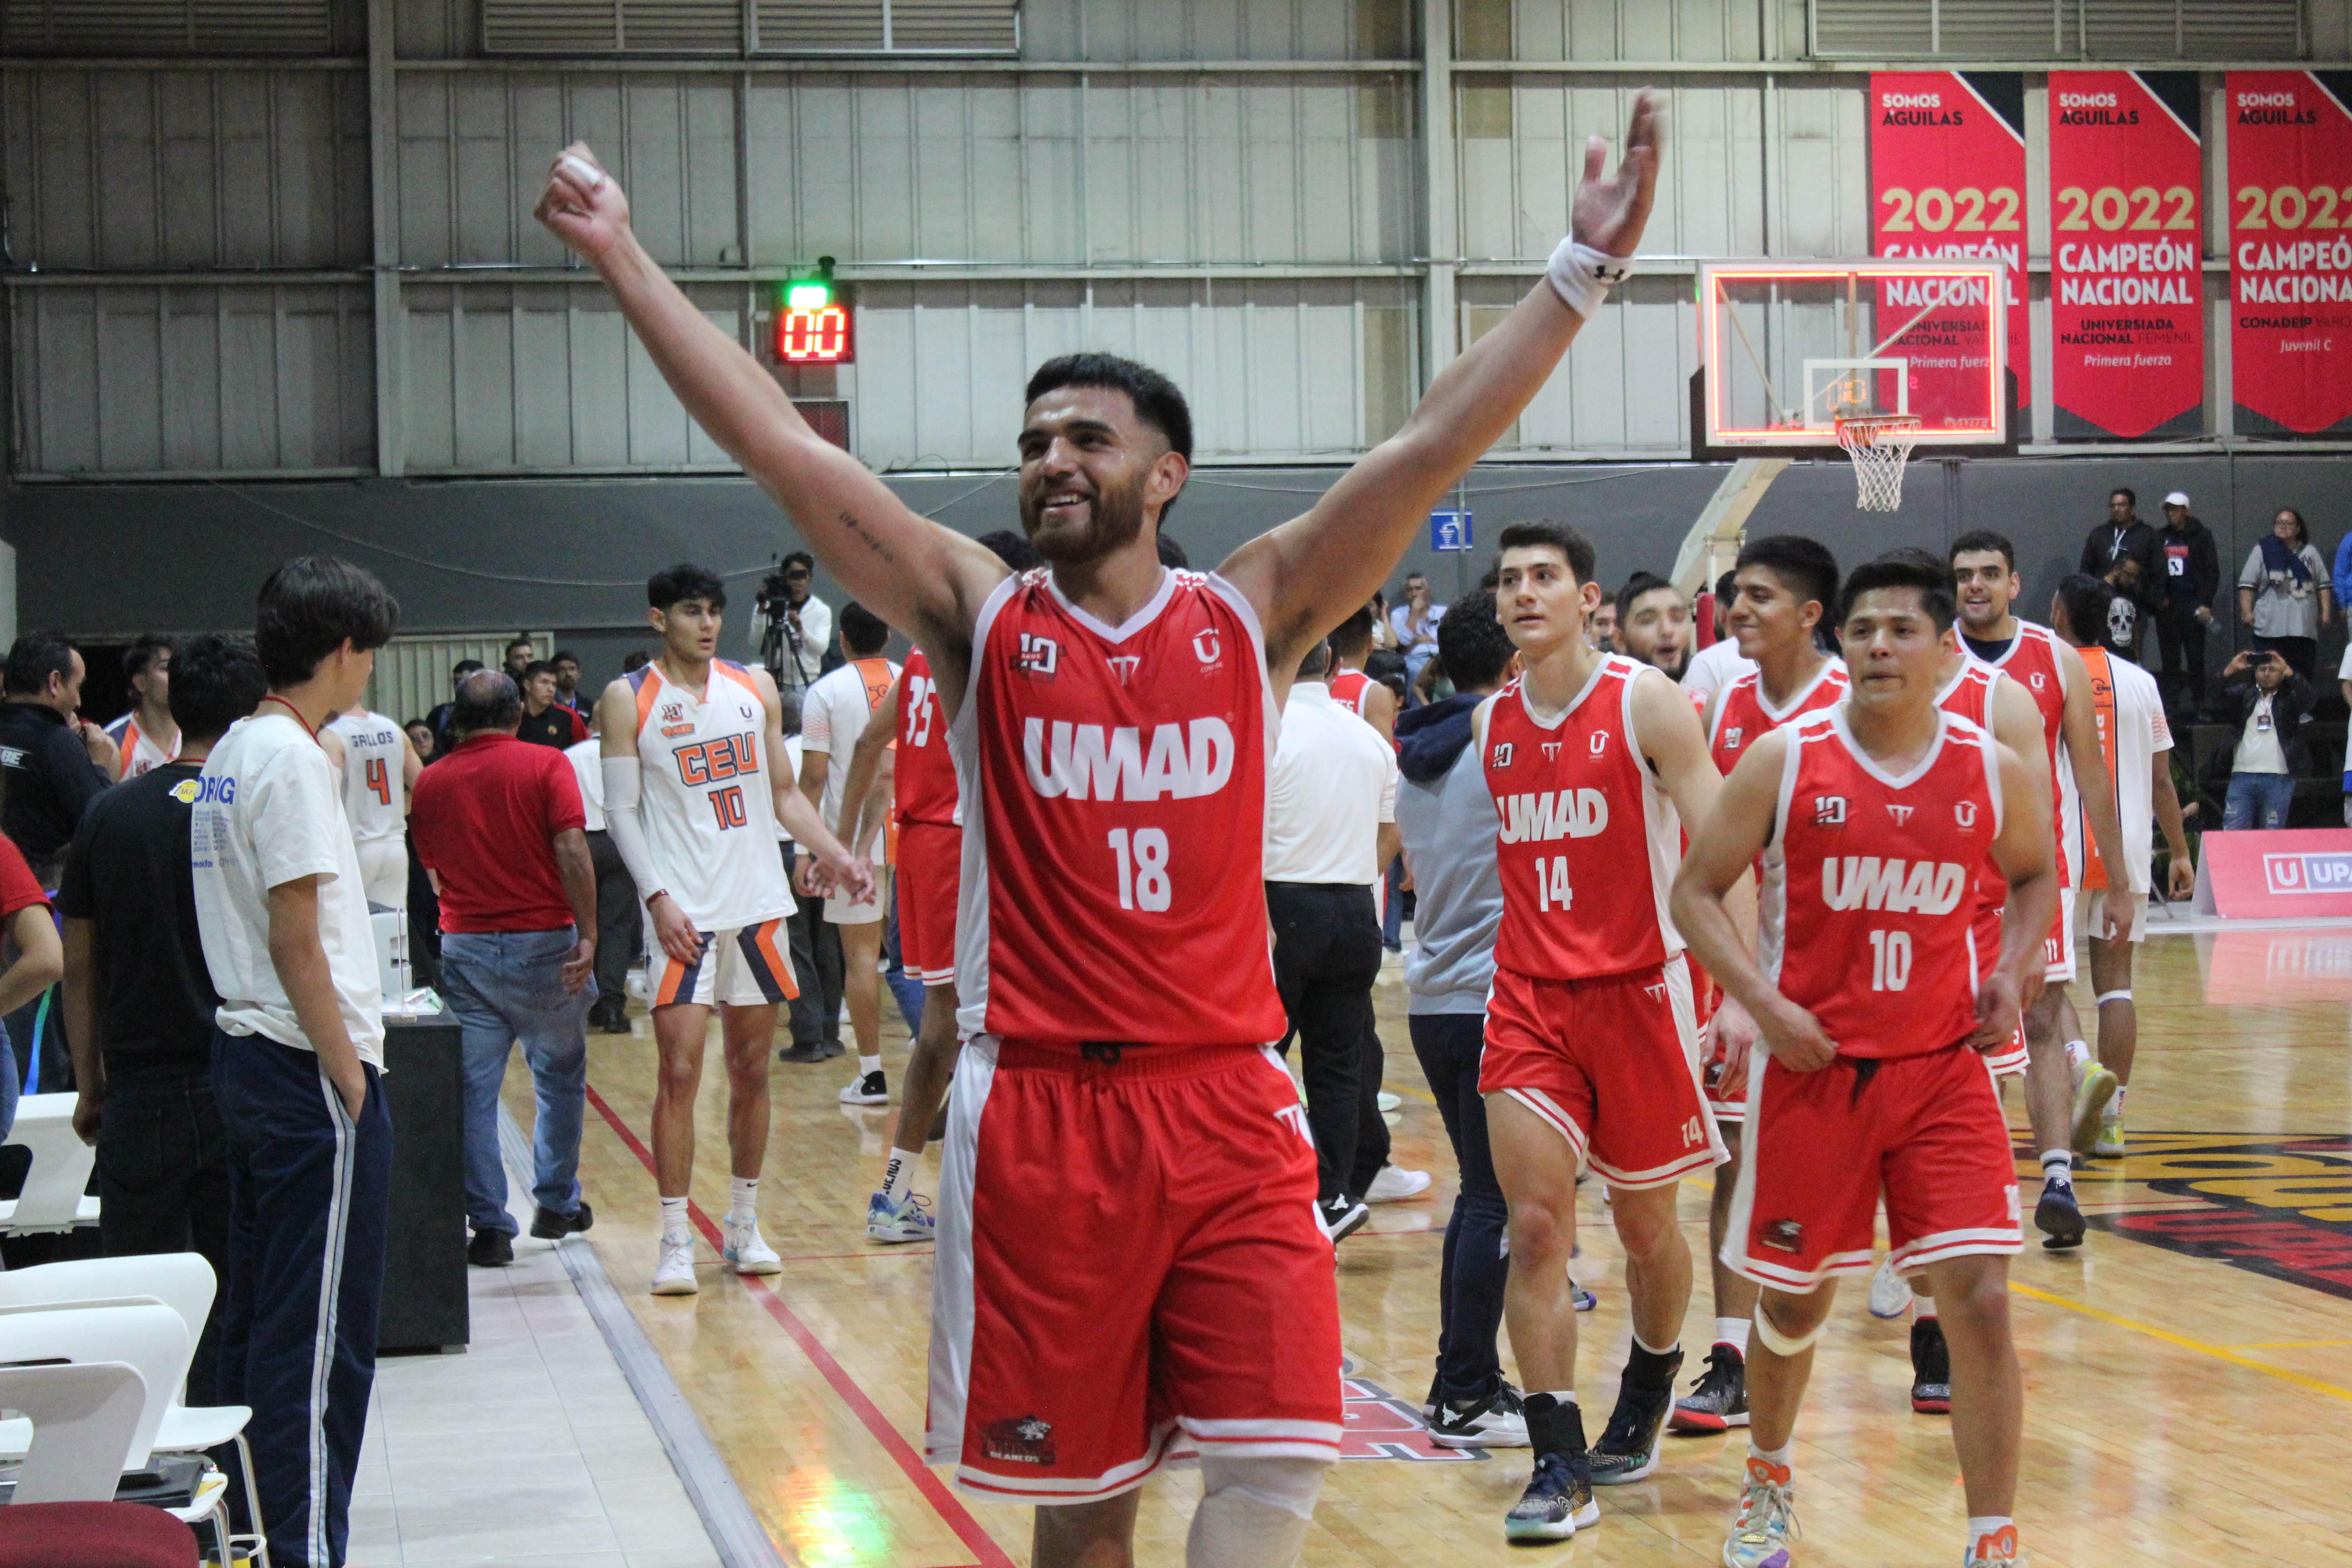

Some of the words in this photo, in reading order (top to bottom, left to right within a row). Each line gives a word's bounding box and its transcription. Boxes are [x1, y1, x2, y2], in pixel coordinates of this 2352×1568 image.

[1882, 93, 1940, 108] SOMOS
[2059, 93, 2117, 107] SOMOS
[2237, 93, 2294, 107] SOMOS
[1882, 187, 2020, 232] 2022
[2057, 186, 2195, 231] 2022
[2059, 236, 2193, 273] CAMPEÓN
[1886, 279, 2019, 307] NACIONL
[2061, 278, 2194, 305] NACIONAL
[784, 308, 845, 358] 00
[2081, 319, 2174, 331] UNIVERSIADA
[2240, 318, 2313, 328] CONADEIP
[1886, 334, 1960, 346] ACIONAL
[2061, 333, 2134, 344] NACIONAL
[2280, 340, 2320, 353] Juvenil
[2324, 340, 2332, 351] C
[1909, 356, 1957, 369] Primera
[2084, 354, 2131, 367] Primera
[2133, 353, 2172, 368] fuerza
[351, 732, 394, 747] GALLOS
[672, 731, 759, 787] CEU
[1023, 716, 1235, 801] UMAD
[366, 758, 391, 805] 4
[708, 785, 747, 831] 10
[1496, 788, 1609, 845] UMAD
[1107, 827, 1172, 912] 18
[2313, 862, 2352, 884] UP
[1535, 856, 1573, 912] 14
[1822, 857, 1966, 916] UMAD
[1869, 930, 1912, 991] 10
[2045, 938, 2058, 962] 11
[1681, 1115, 1704, 1148] 14
